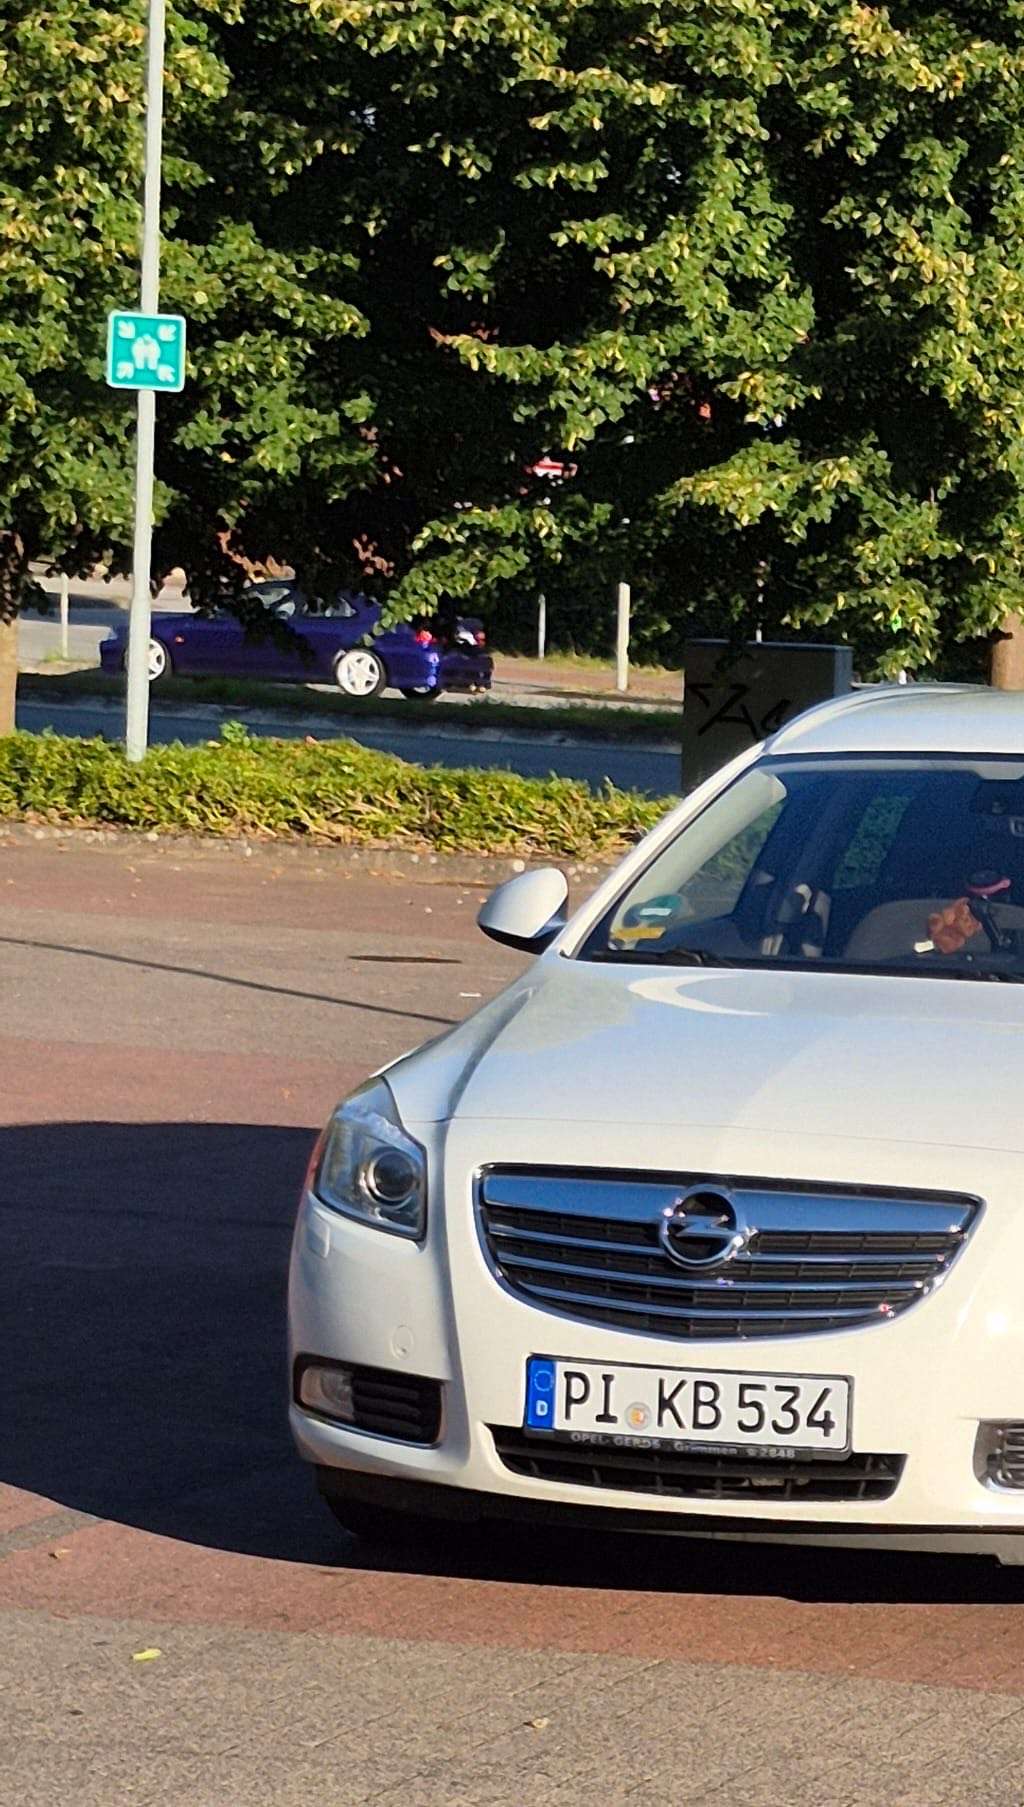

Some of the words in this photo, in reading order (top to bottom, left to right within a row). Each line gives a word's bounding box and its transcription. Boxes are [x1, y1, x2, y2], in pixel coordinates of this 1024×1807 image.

[535, 1400, 548, 1416] D
[563, 1371, 618, 1424] PI
[657, 1377, 722, 1431] KB
[737, 1382, 836, 1437] 534
